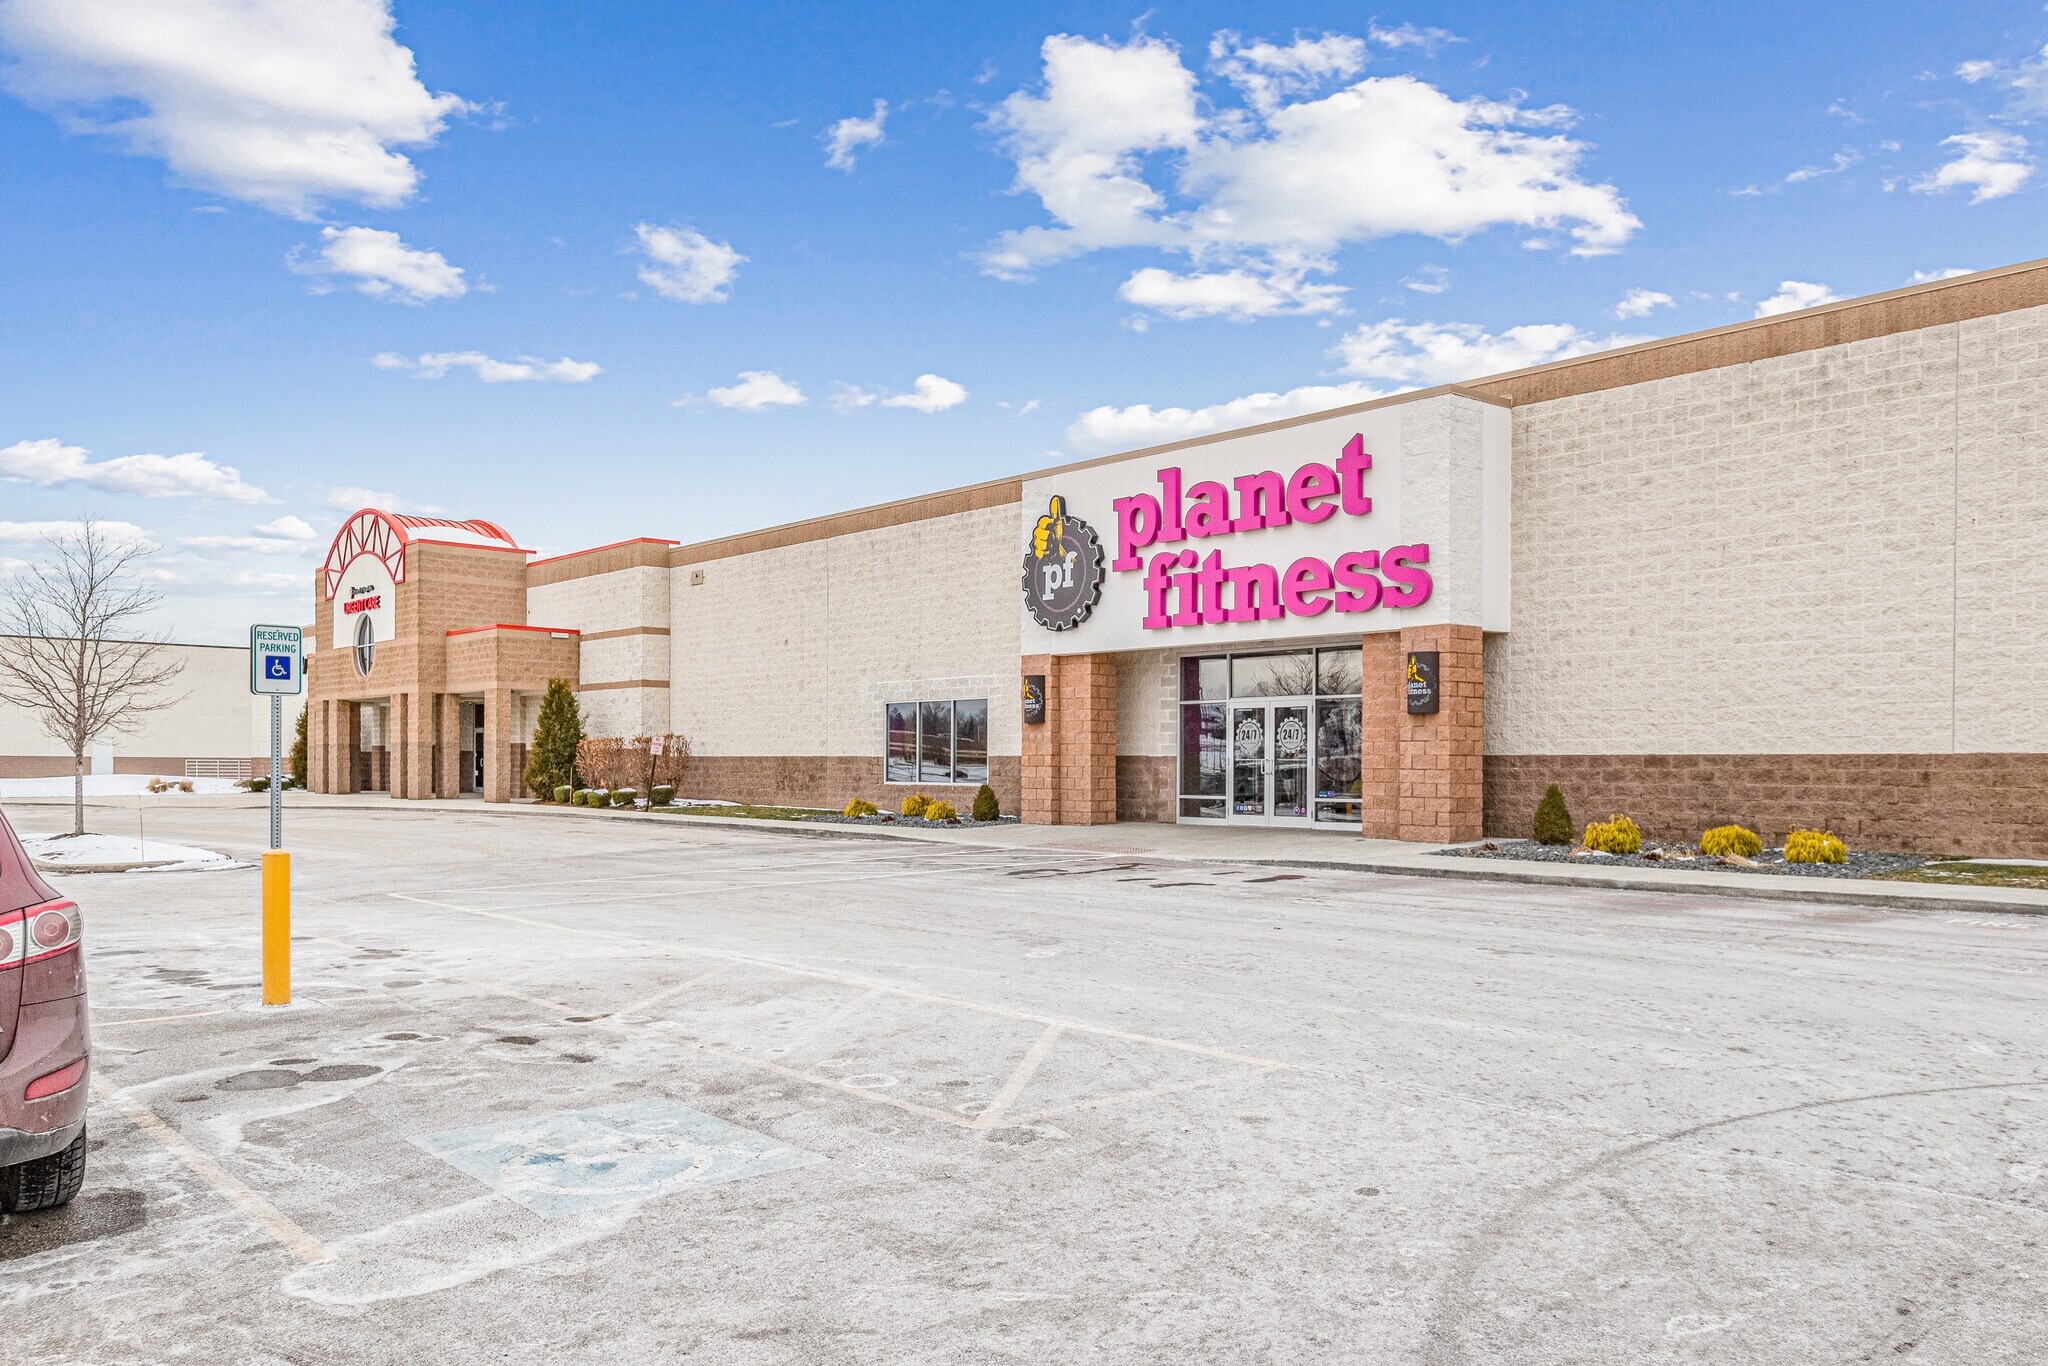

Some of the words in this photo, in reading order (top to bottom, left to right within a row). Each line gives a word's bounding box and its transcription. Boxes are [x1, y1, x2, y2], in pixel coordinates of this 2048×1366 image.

[1113, 432, 1372, 572] planet
[1042, 551, 1078, 600] pf
[1143, 543, 1433, 630] fitness
[364, 596, 380, 610] CARE
[257, 630, 299, 641] RESERVED
[260, 643, 296, 653] PARKING
[1241, 729, 1257, 741] 24/7
[1283, 728, 1299, 740] 24/7
[1945, 919, 2040, 928] FIRE
